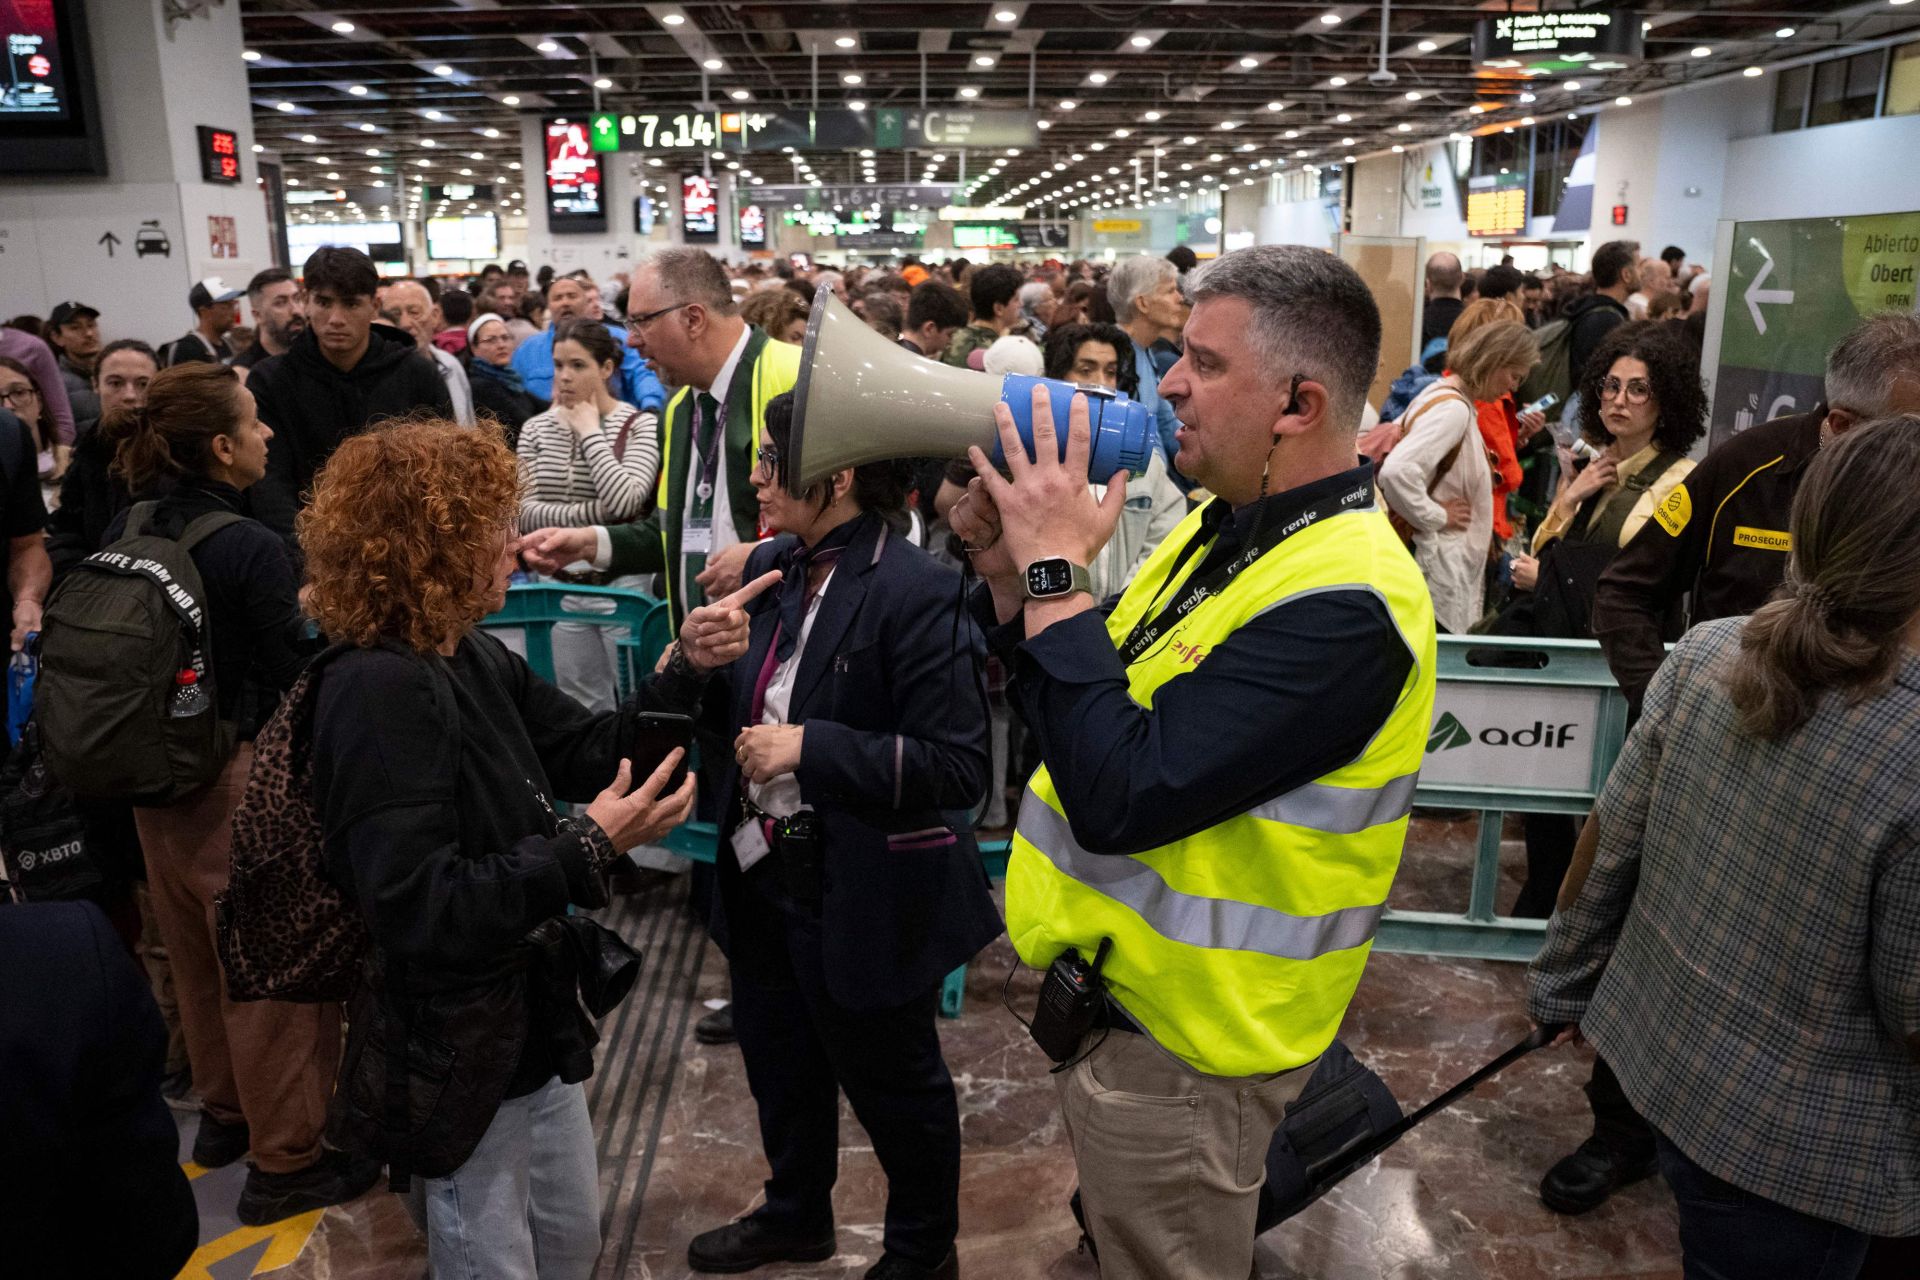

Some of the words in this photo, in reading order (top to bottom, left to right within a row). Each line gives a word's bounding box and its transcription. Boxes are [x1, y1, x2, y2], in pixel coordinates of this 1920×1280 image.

[638, 114, 659, 147] 7
[673, 114, 715, 147] 14
[924, 112, 941, 142] C
[1864, 234, 1919, 254] Abierto
[1871, 263, 1914, 283] Obert
[1885, 293, 1910, 306] OPEN
[1340, 485, 1368, 505] renfe
[1282, 510, 1318, 536] renfe
[1738, 532, 1790, 547] PROSEGUR
[99, 552, 132, 569] LIFE
[166, 583, 195, 609] AND
[1040, 567, 1048, 590] 10:44
[1177, 586, 1207, 614] renfe
[1130, 627, 1158, 656] renfe
[1479, 721, 1579, 748] adif
[39, 840, 82, 864] XBTO
